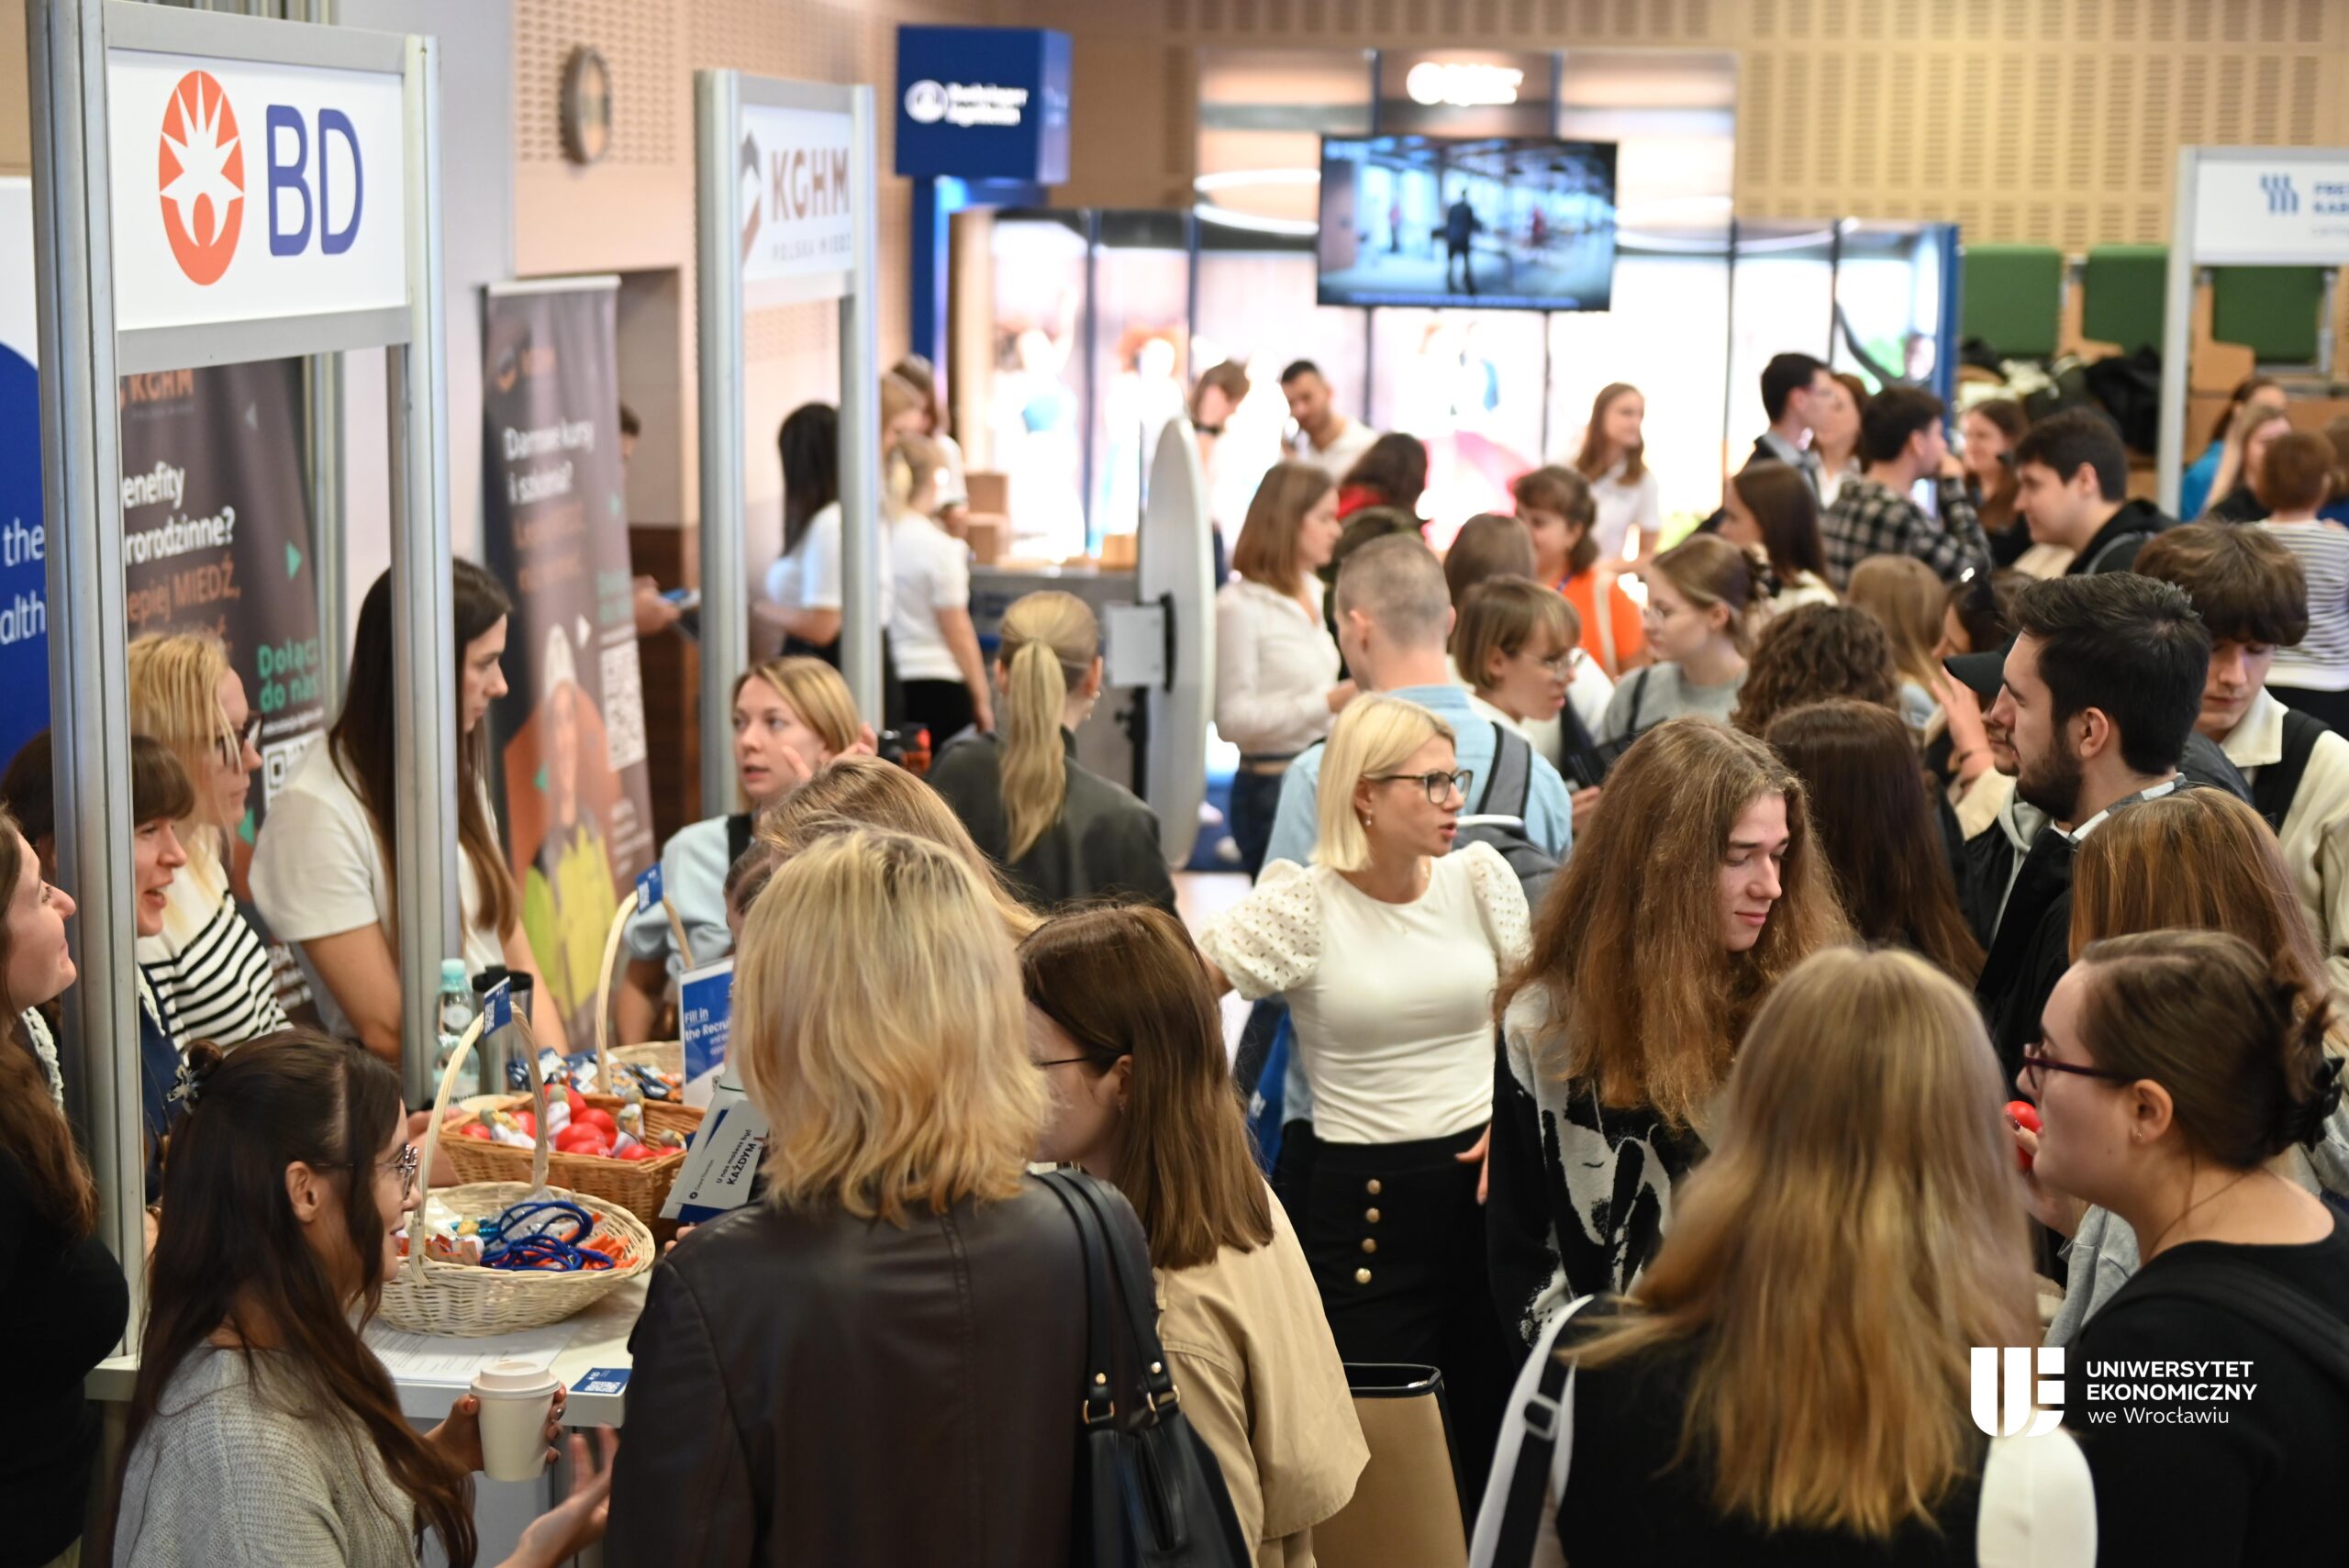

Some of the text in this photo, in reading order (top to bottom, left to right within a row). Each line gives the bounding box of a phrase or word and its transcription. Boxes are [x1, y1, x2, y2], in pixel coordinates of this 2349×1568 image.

[266, 104, 363, 256] BD
[772, 147, 850, 223] KGHM
[123, 461, 185, 510] enefity
[3, 517, 45, 567] the
[126, 506, 236, 566] rorodzinne?
[0, 589, 46, 645] alth
[128, 576, 171, 628] epiej
[685, 1007, 709, 1024] Fill in
[685, 1028, 701, 1041] the
[726, 1142, 757, 1185] KAŻDYM
